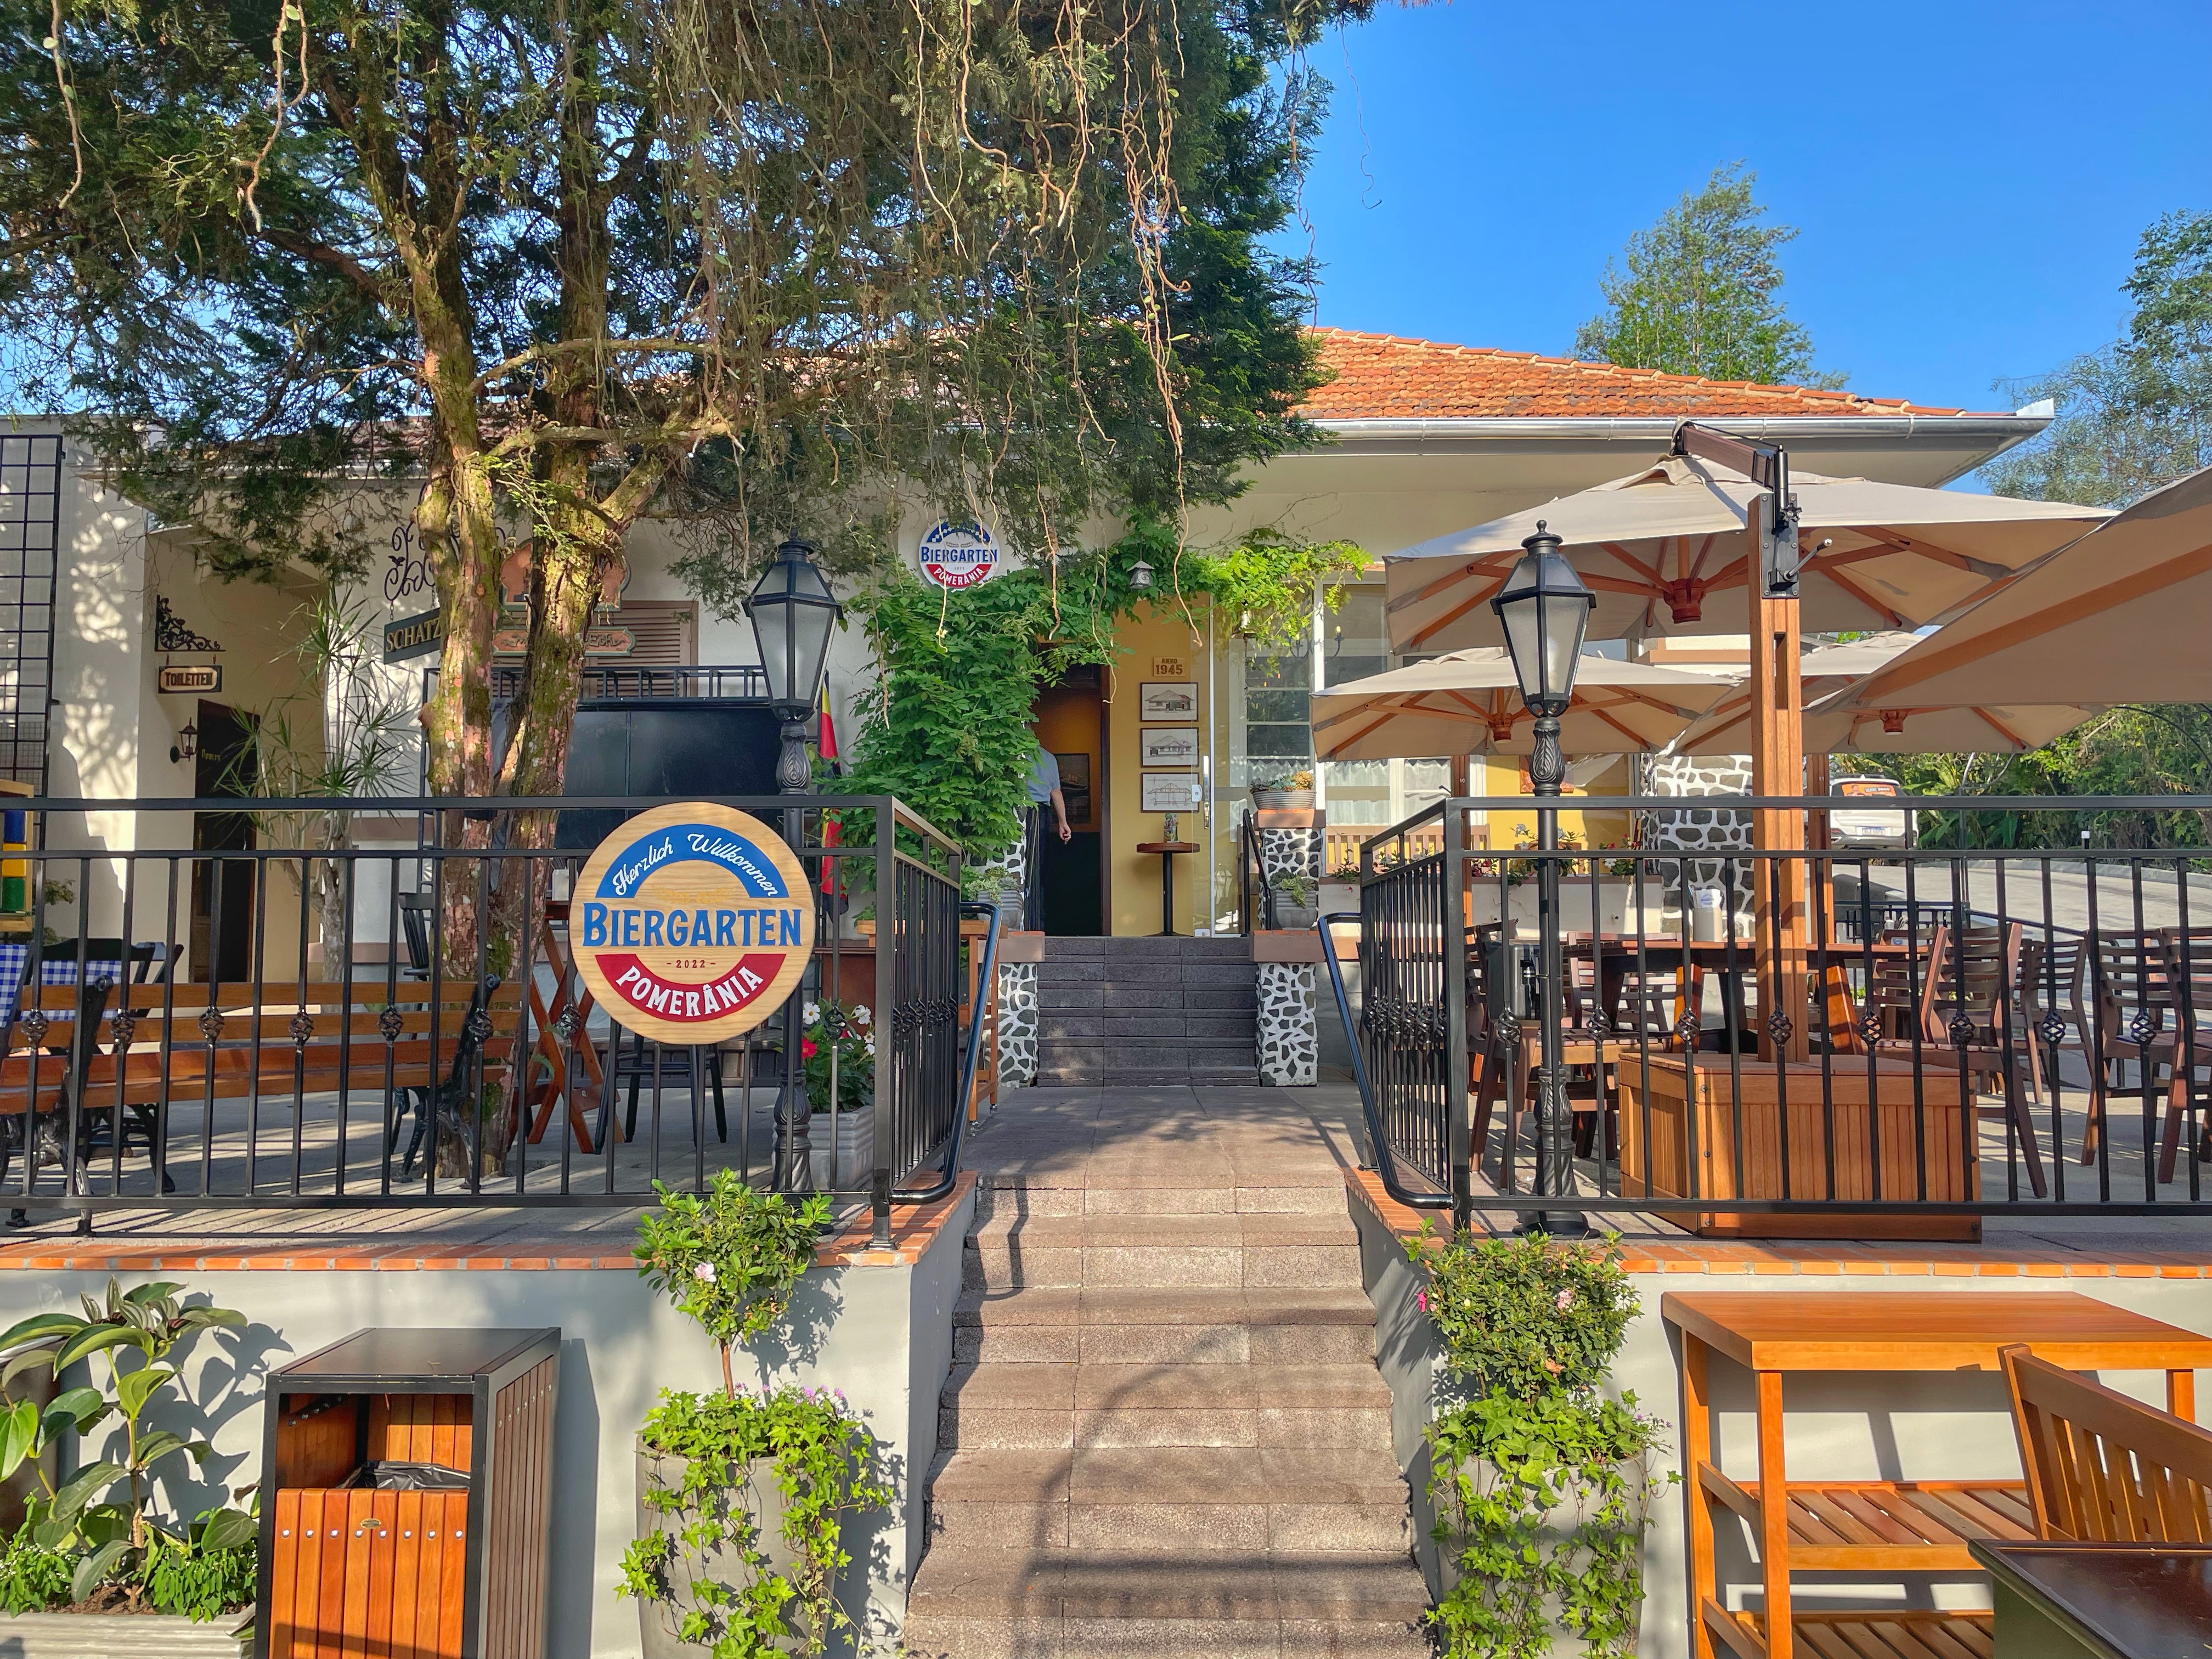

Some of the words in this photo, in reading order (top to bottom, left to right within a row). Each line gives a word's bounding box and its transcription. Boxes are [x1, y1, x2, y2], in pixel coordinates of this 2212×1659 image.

[921, 546, 997, 562] BIERGARTEN
[933, 567, 984, 585] POMERÂNIA
[1155, 664, 1183, 675] 1945
[165, 672, 213, 686] TOILETTEN
[612, 837, 674, 896] Herzlich
[687, 833, 778, 897] Willkommen
[582, 902, 802, 946] BIERGARTEN
[615, 965, 764, 1017] POMERÂNIA
